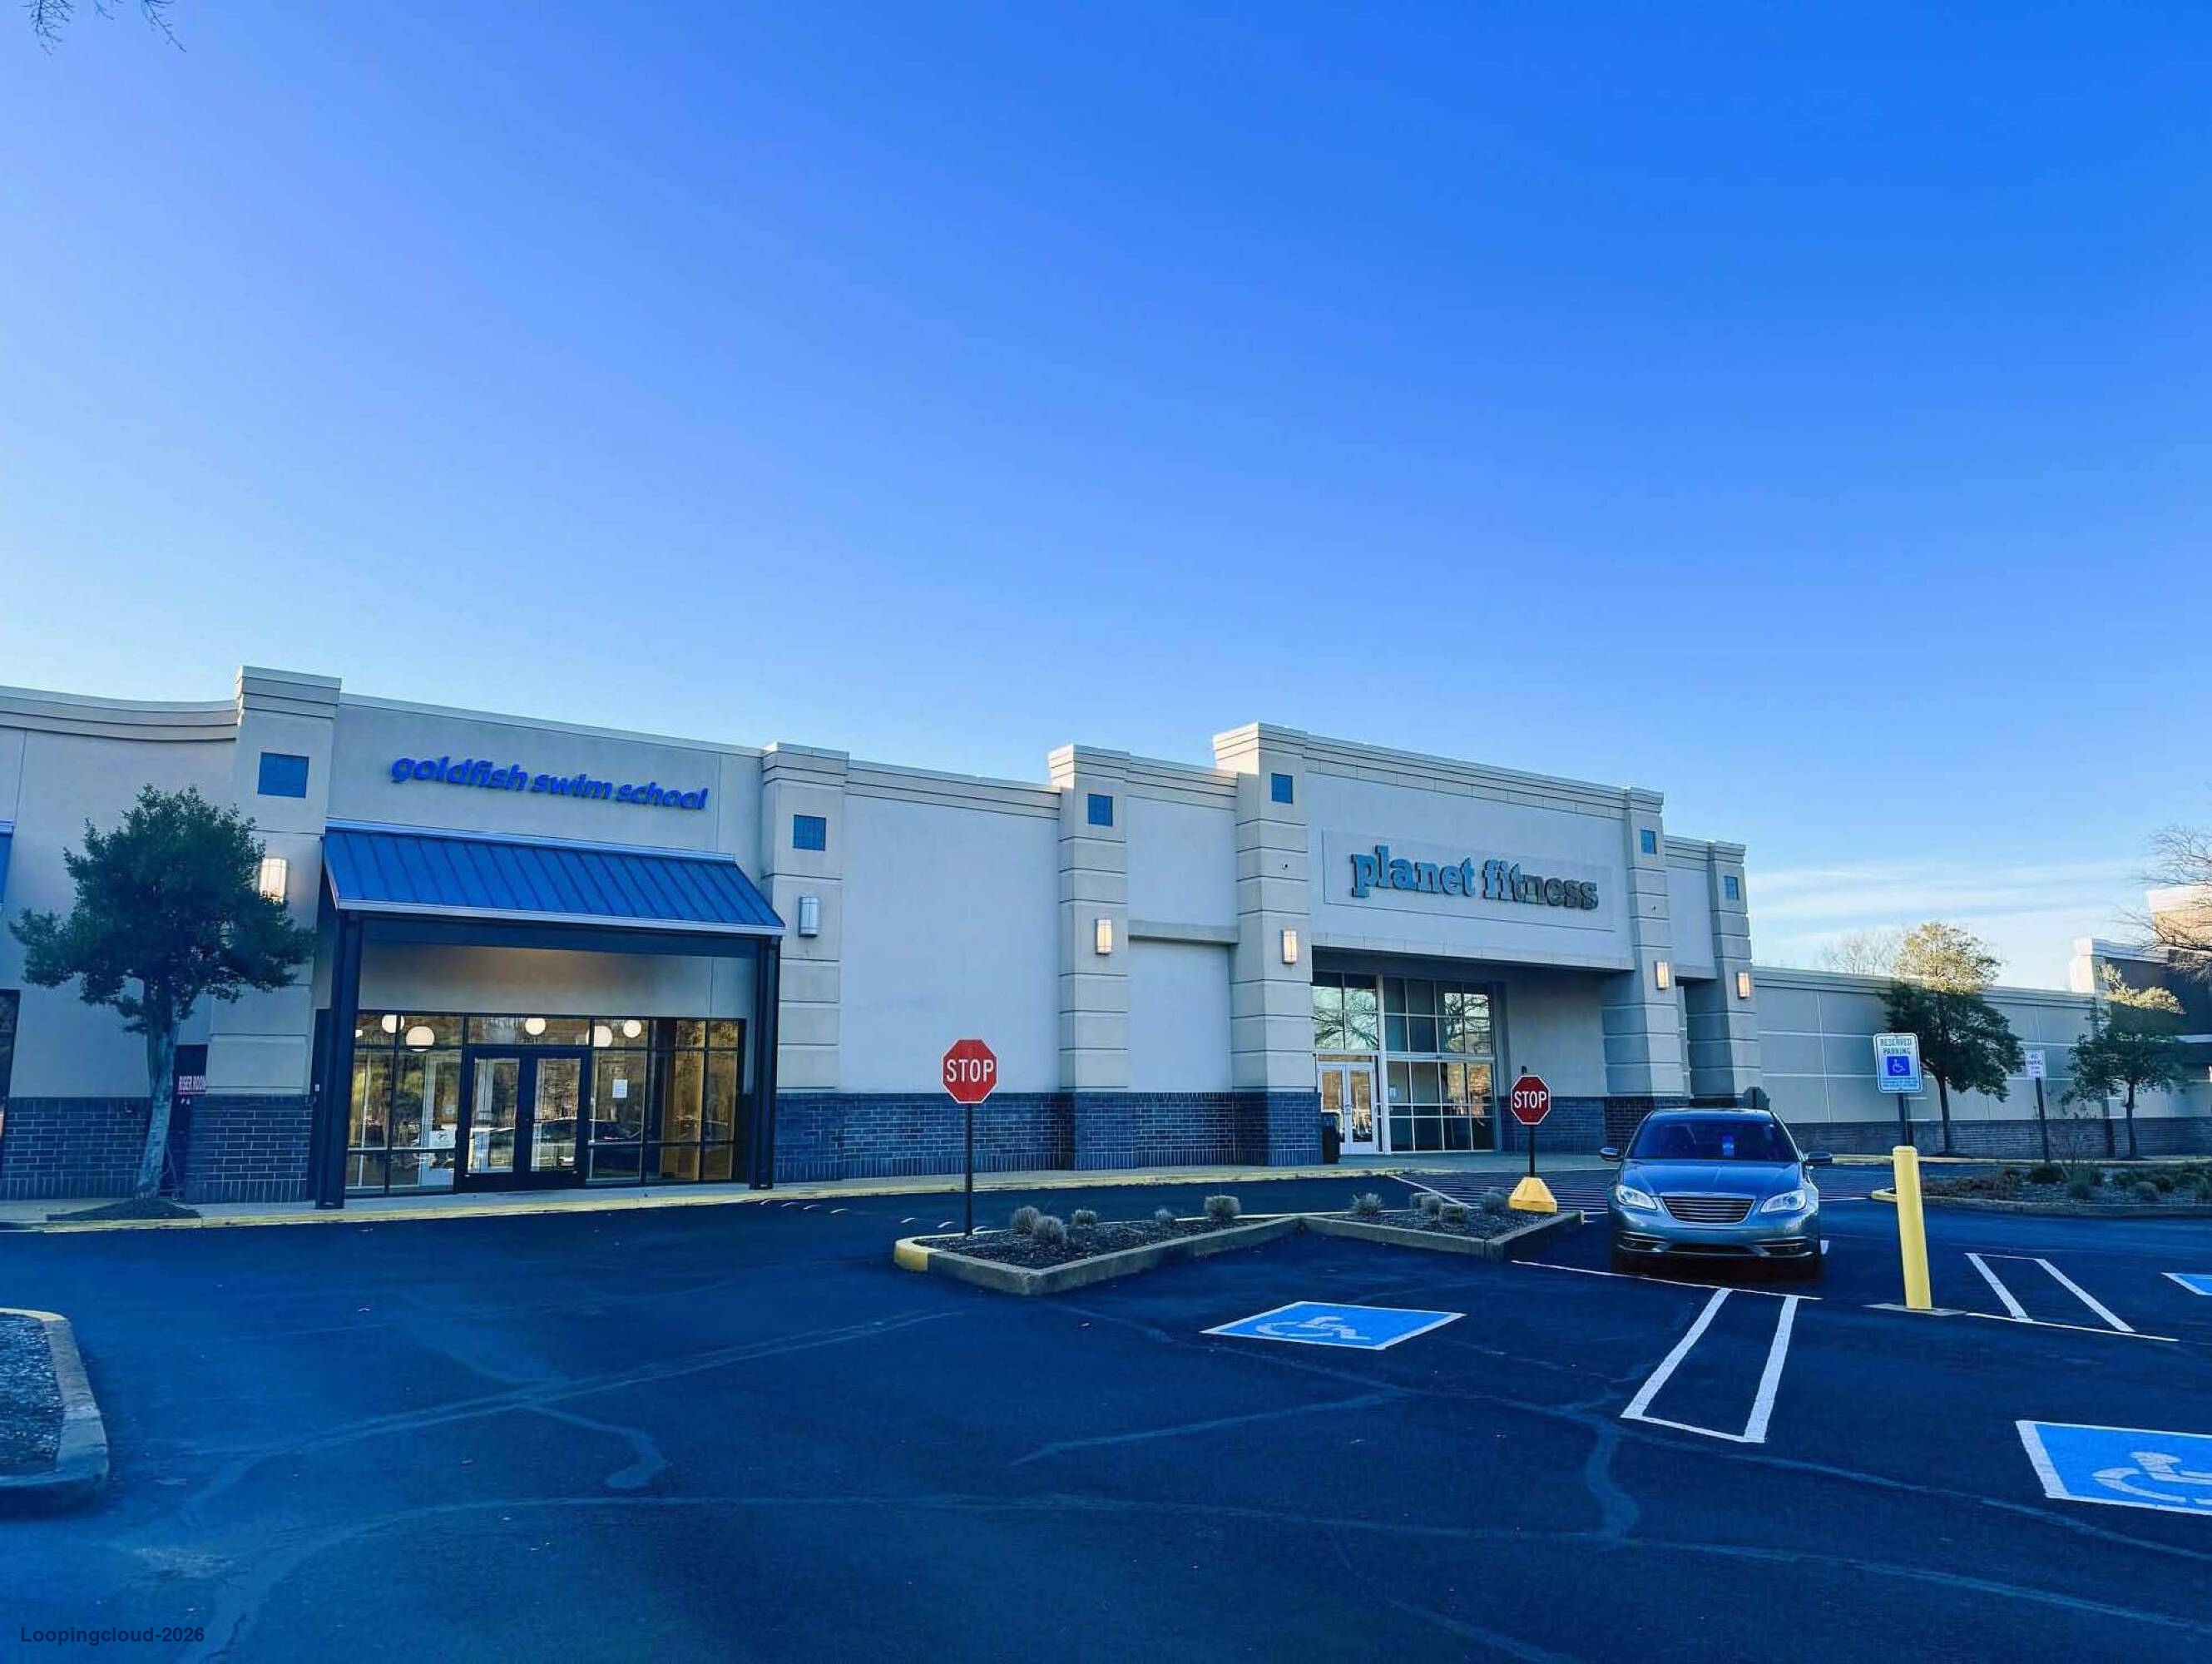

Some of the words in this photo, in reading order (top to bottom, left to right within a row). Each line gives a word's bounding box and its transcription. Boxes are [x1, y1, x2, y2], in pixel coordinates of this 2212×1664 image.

[391, 755, 528, 790] goldfish
[532, 774, 613, 800] swim
[616, 781, 709, 810] school
[1350, 844, 1476, 898] planet
[1482, 859, 1599, 910] fitness
[1879, 1038, 1912, 1047] RESERVED
[1883, 1047, 1911, 1055] PARKING
[946, 1058, 994, 1082] STOP
[1514, 1091, 1546, 1108] STOP
